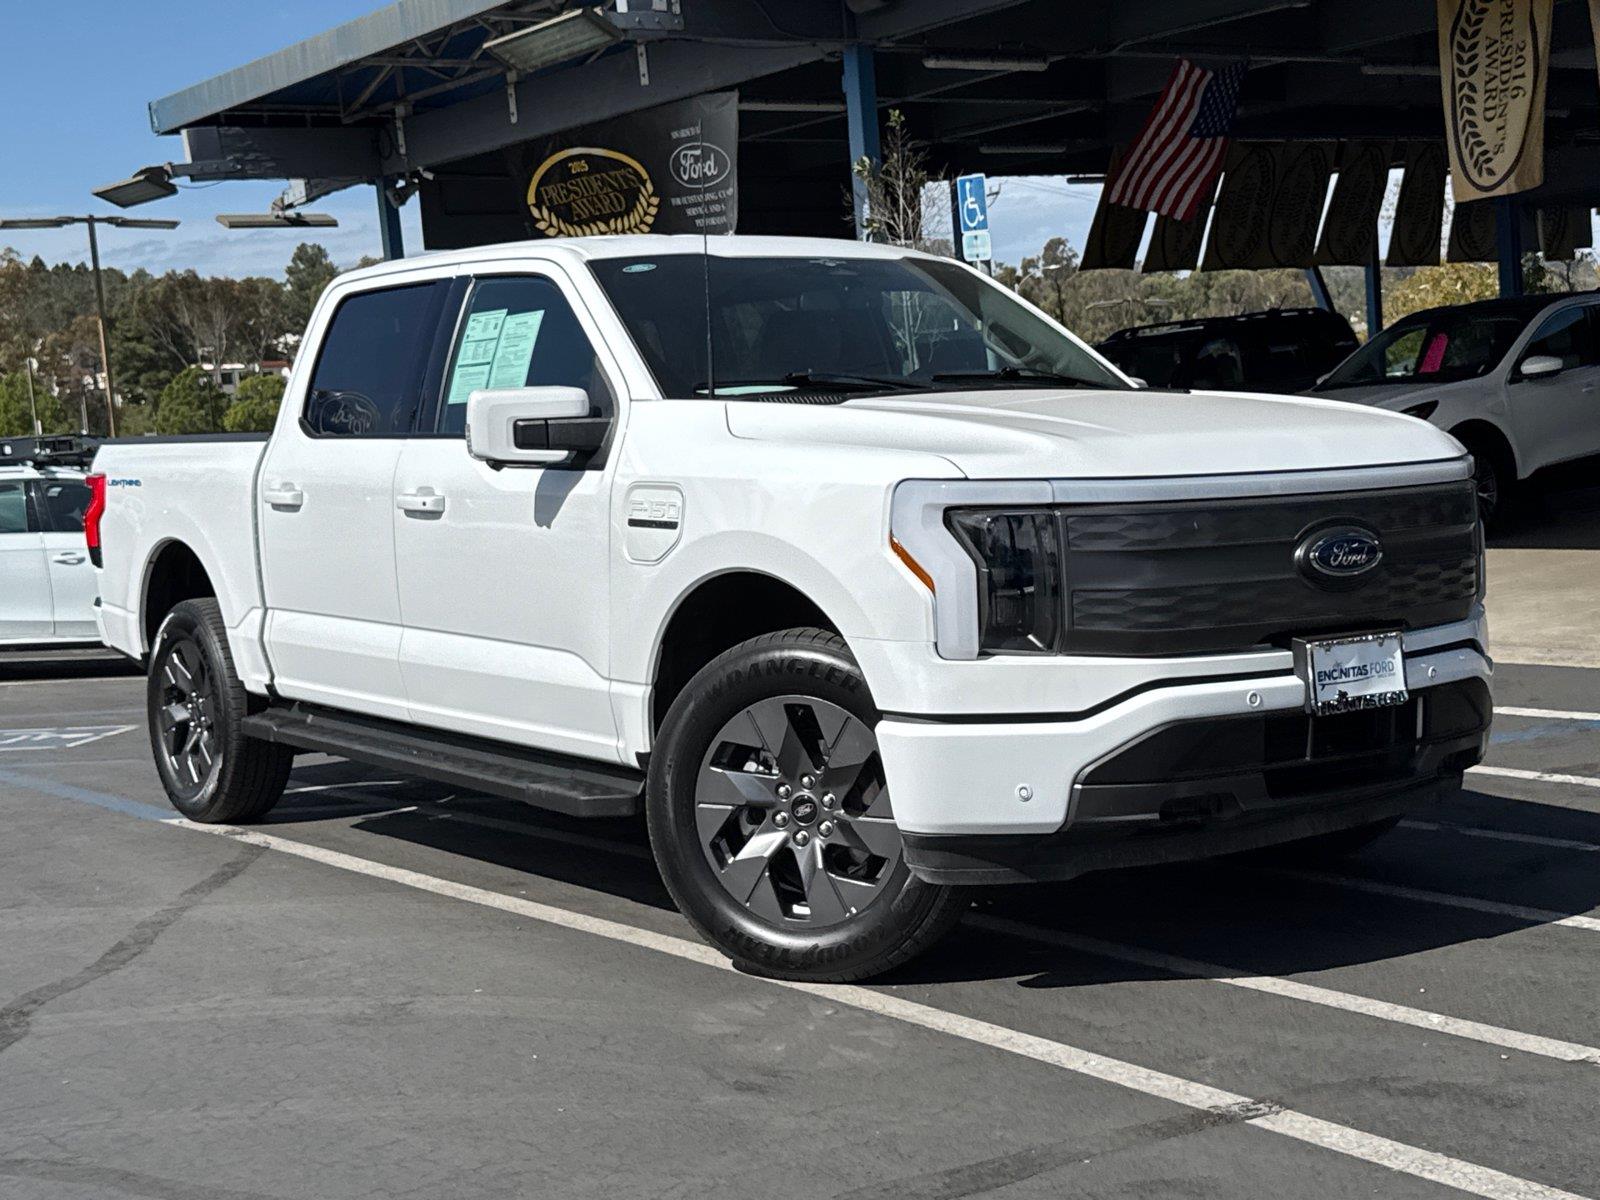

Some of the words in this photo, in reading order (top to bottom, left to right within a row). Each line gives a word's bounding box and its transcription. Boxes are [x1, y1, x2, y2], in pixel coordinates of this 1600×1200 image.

[1482, 36, 1499, 123] AWARD
[1511, 40, 1527, 99] 2016
[680, 149, 718, 181] Ford
[541, 168, 640, 206] PRESIDENT'S
[571, 191, 626, 220] AWARD
[1331, 543, 1369, 566] Ford
[1369, 660, 1395, 674] FORD
